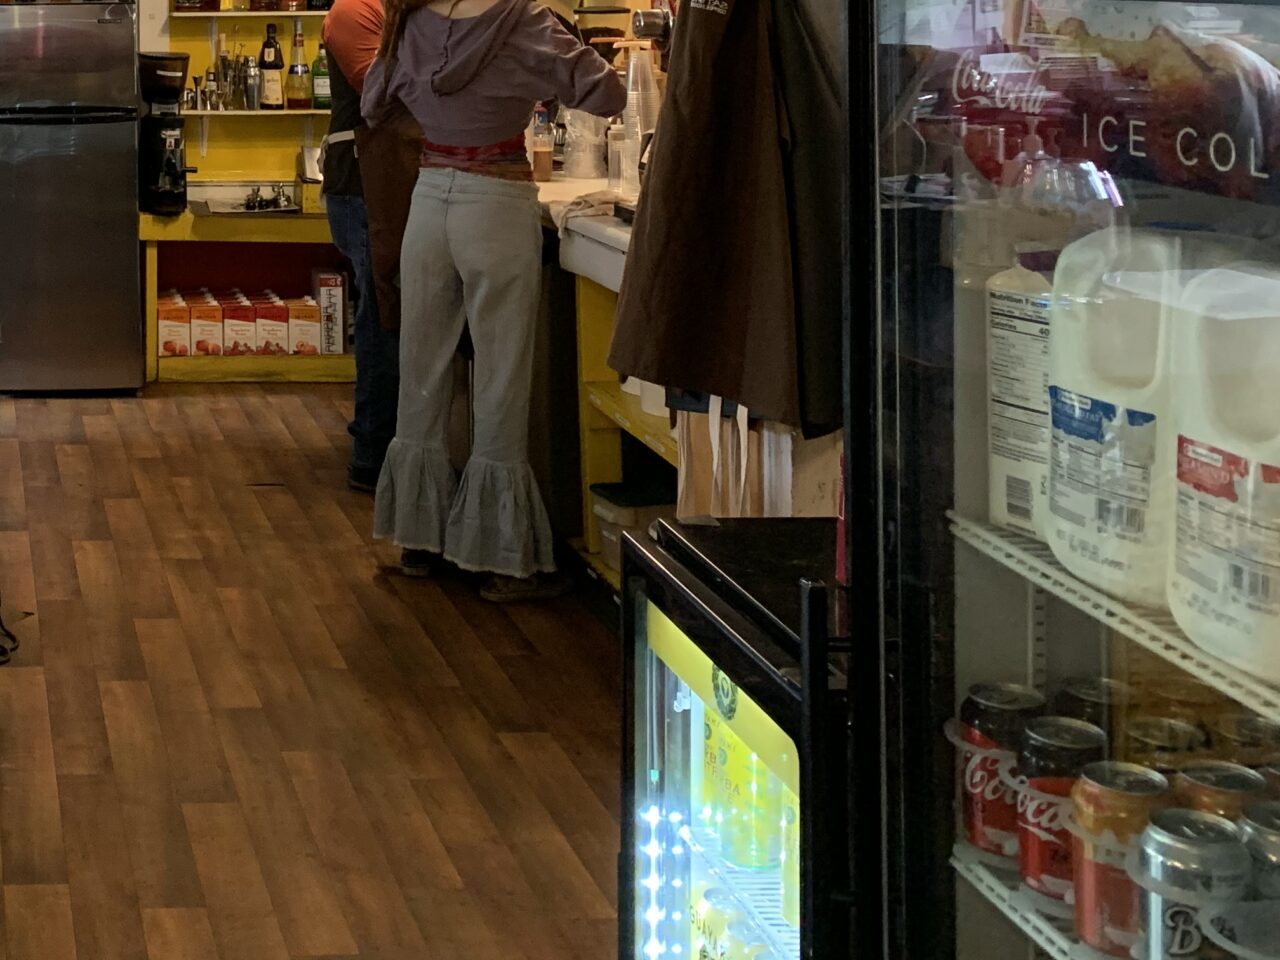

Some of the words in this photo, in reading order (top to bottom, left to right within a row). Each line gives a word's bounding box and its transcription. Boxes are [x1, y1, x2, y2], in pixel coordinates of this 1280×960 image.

[952, 48, 1048, 114] Coca-Cola
[1081, 113, 1147, 157] ICE
[1176, 127, 1270, 179] COL
[990, 291, 1024, 304] Nutrition
[992, 321, 1017, 331] Calories
[1038, 327, 1050, 337] 40
